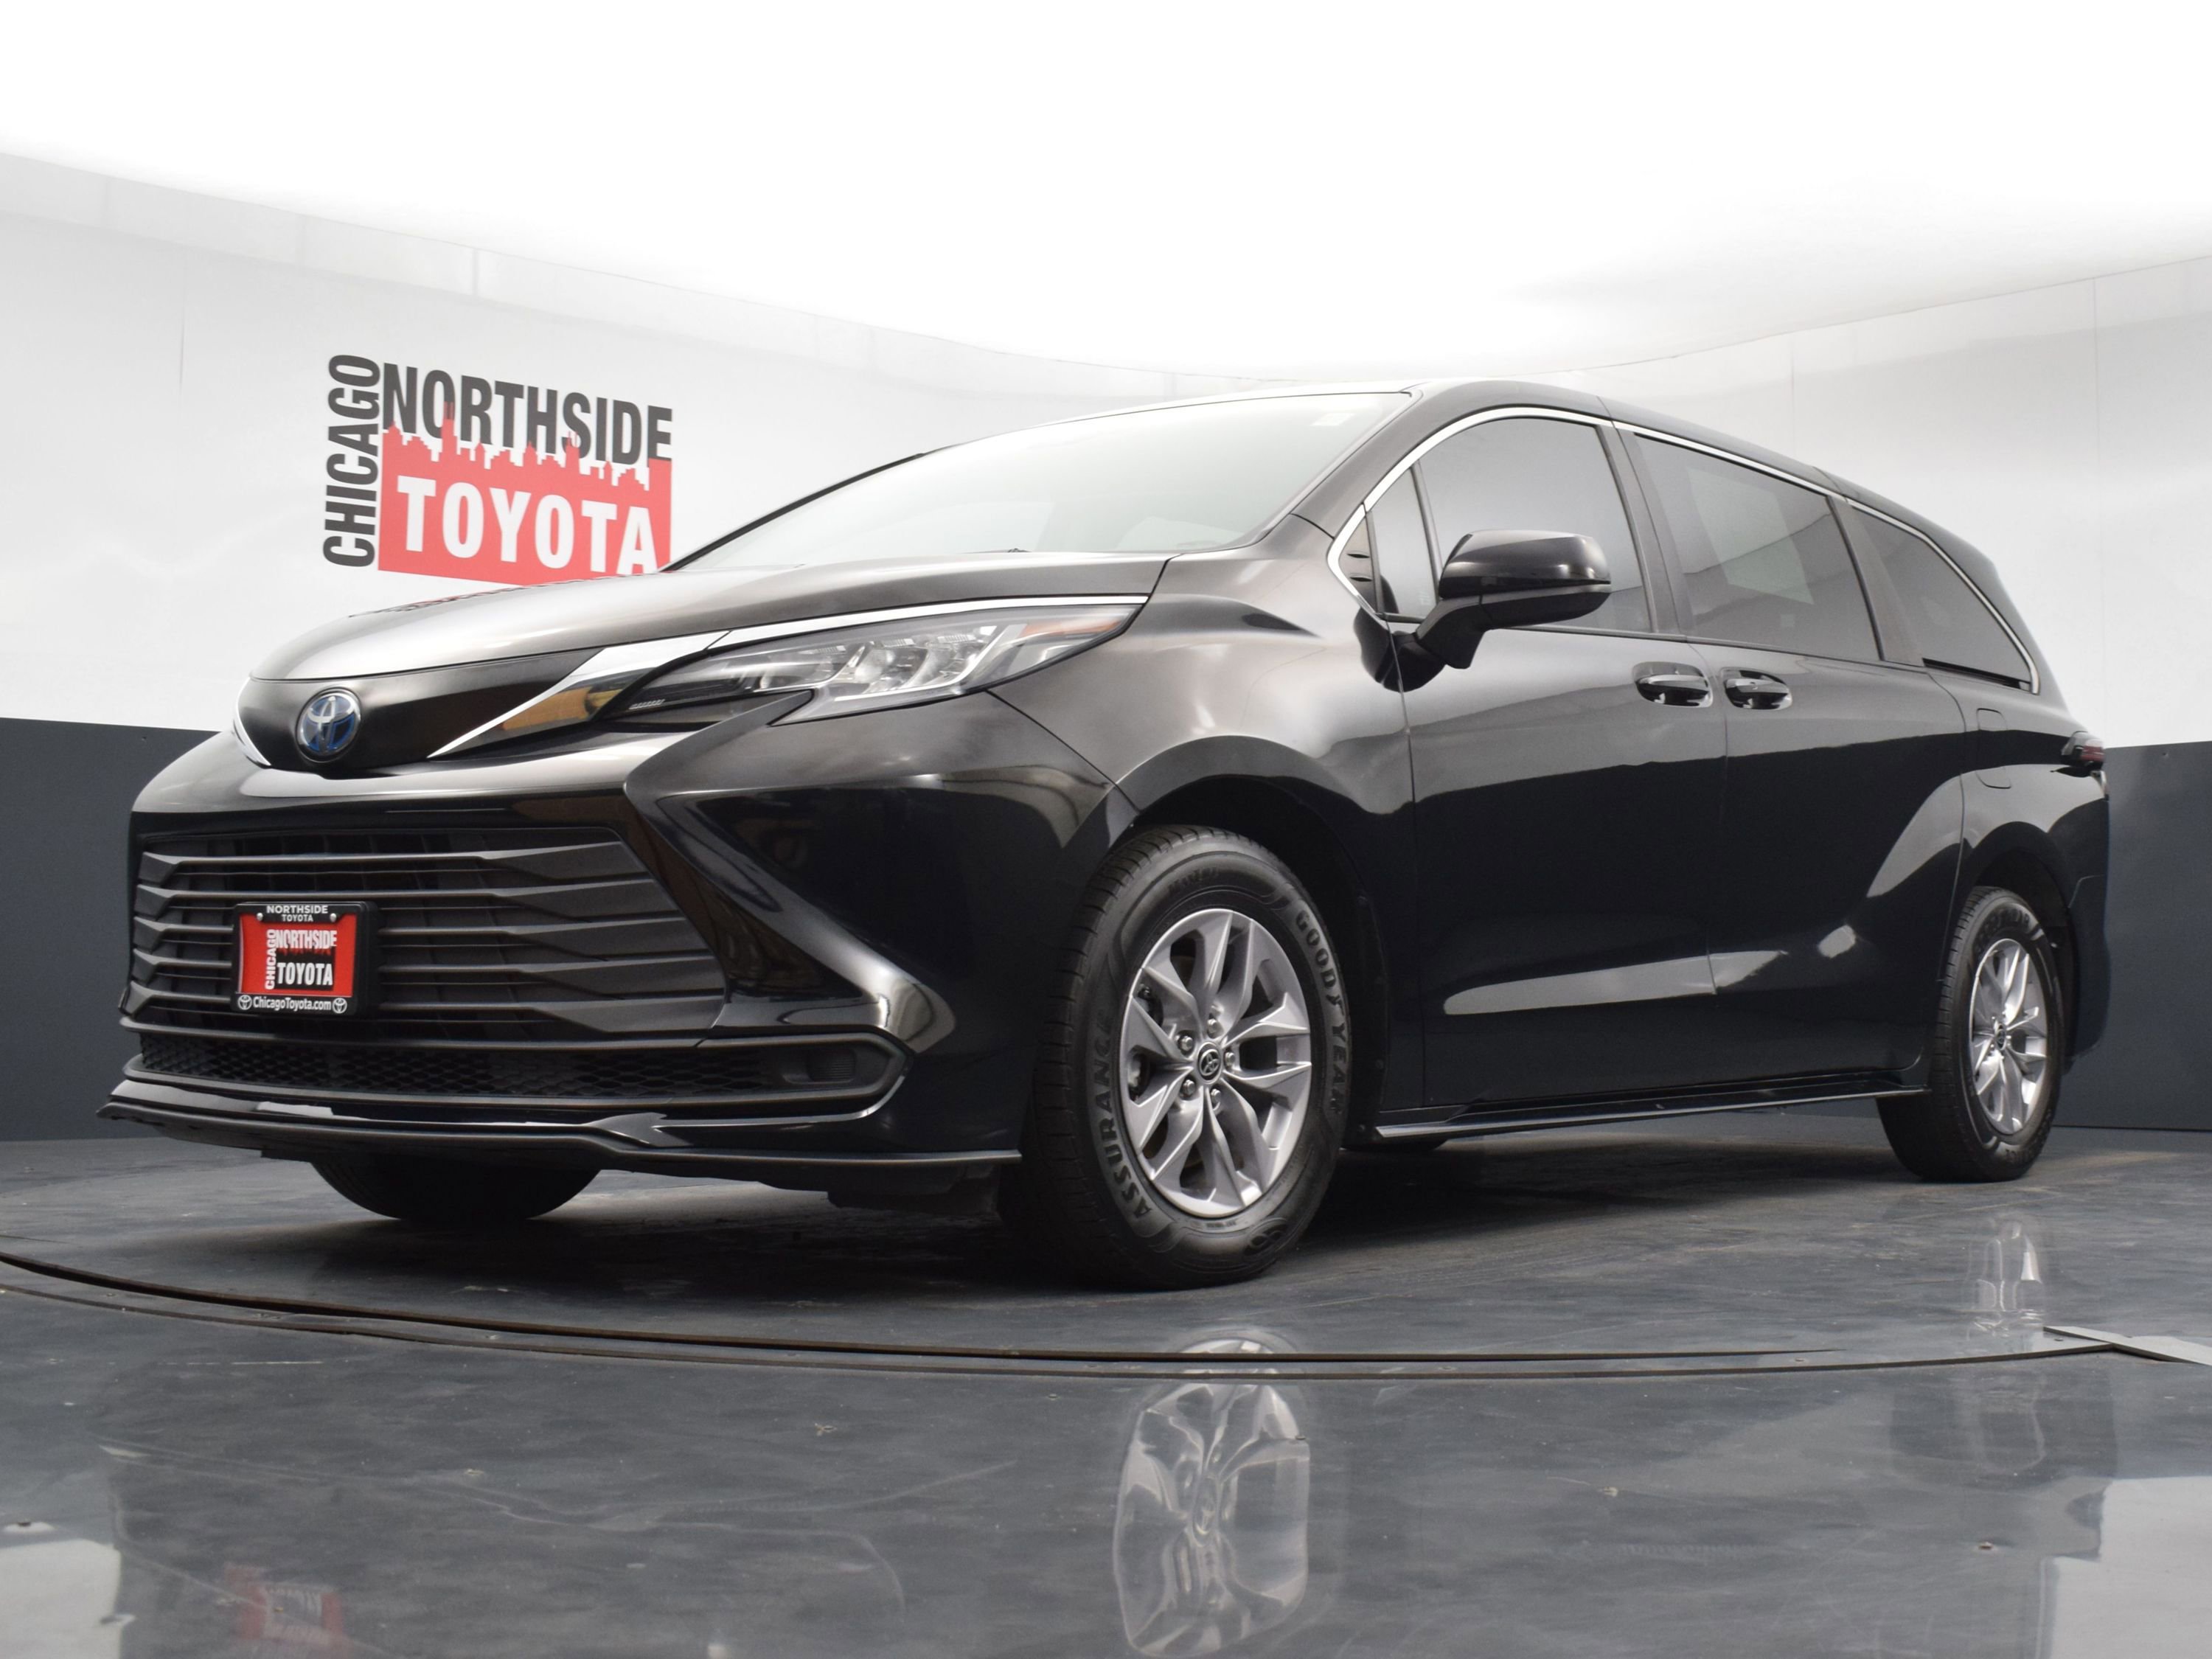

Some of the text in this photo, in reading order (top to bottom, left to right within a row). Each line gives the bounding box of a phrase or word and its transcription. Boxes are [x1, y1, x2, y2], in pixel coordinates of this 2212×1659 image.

[383, 362, 672, 466] NORTHSIDE
[323, 354, 380, 568] CHICAGO
[397, 475, 658, 575] TOYOTA
[266, 905, 328, 914] NORTHSIDE
[265, 929, 276, 990] CHICAGO
[275, 929, 338, 950] NORTHSIDE
[276, 962, 333, 986] TOYOTA
[253, 996, 332, 1012] ChicagoToyota.com
